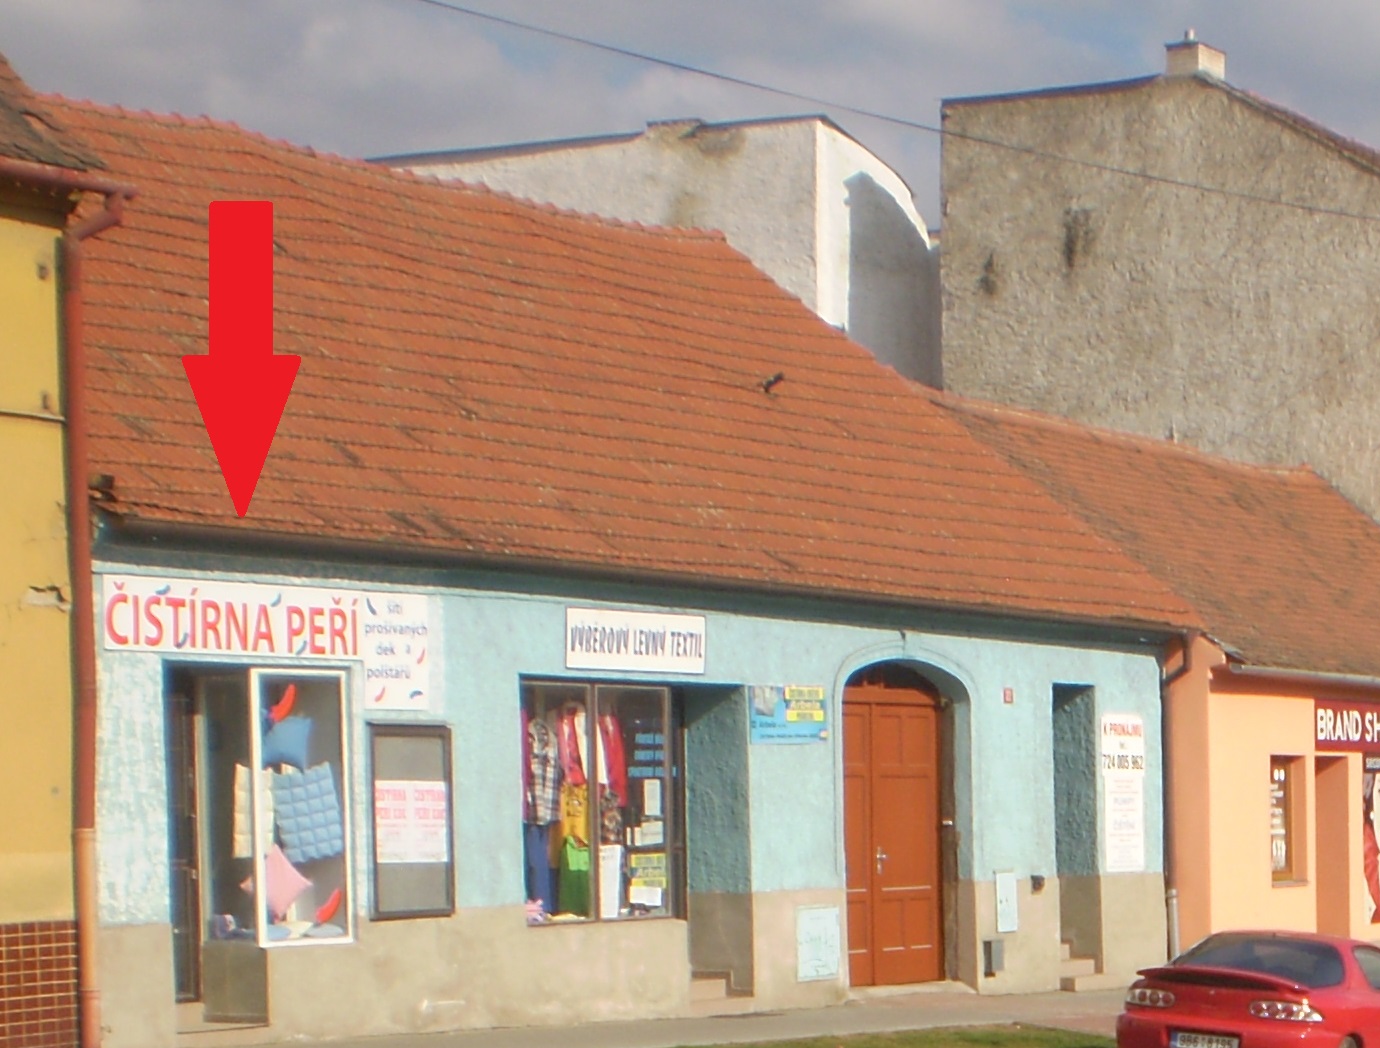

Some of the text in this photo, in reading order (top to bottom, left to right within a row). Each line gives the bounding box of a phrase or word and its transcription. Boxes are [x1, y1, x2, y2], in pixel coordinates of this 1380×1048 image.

[105, 581, 359, 656] ČISTÍRNA PEŘÍ
[671, 631, 703, 658] TEXTIL
[1317, 708, 1363, 742] BRAND
